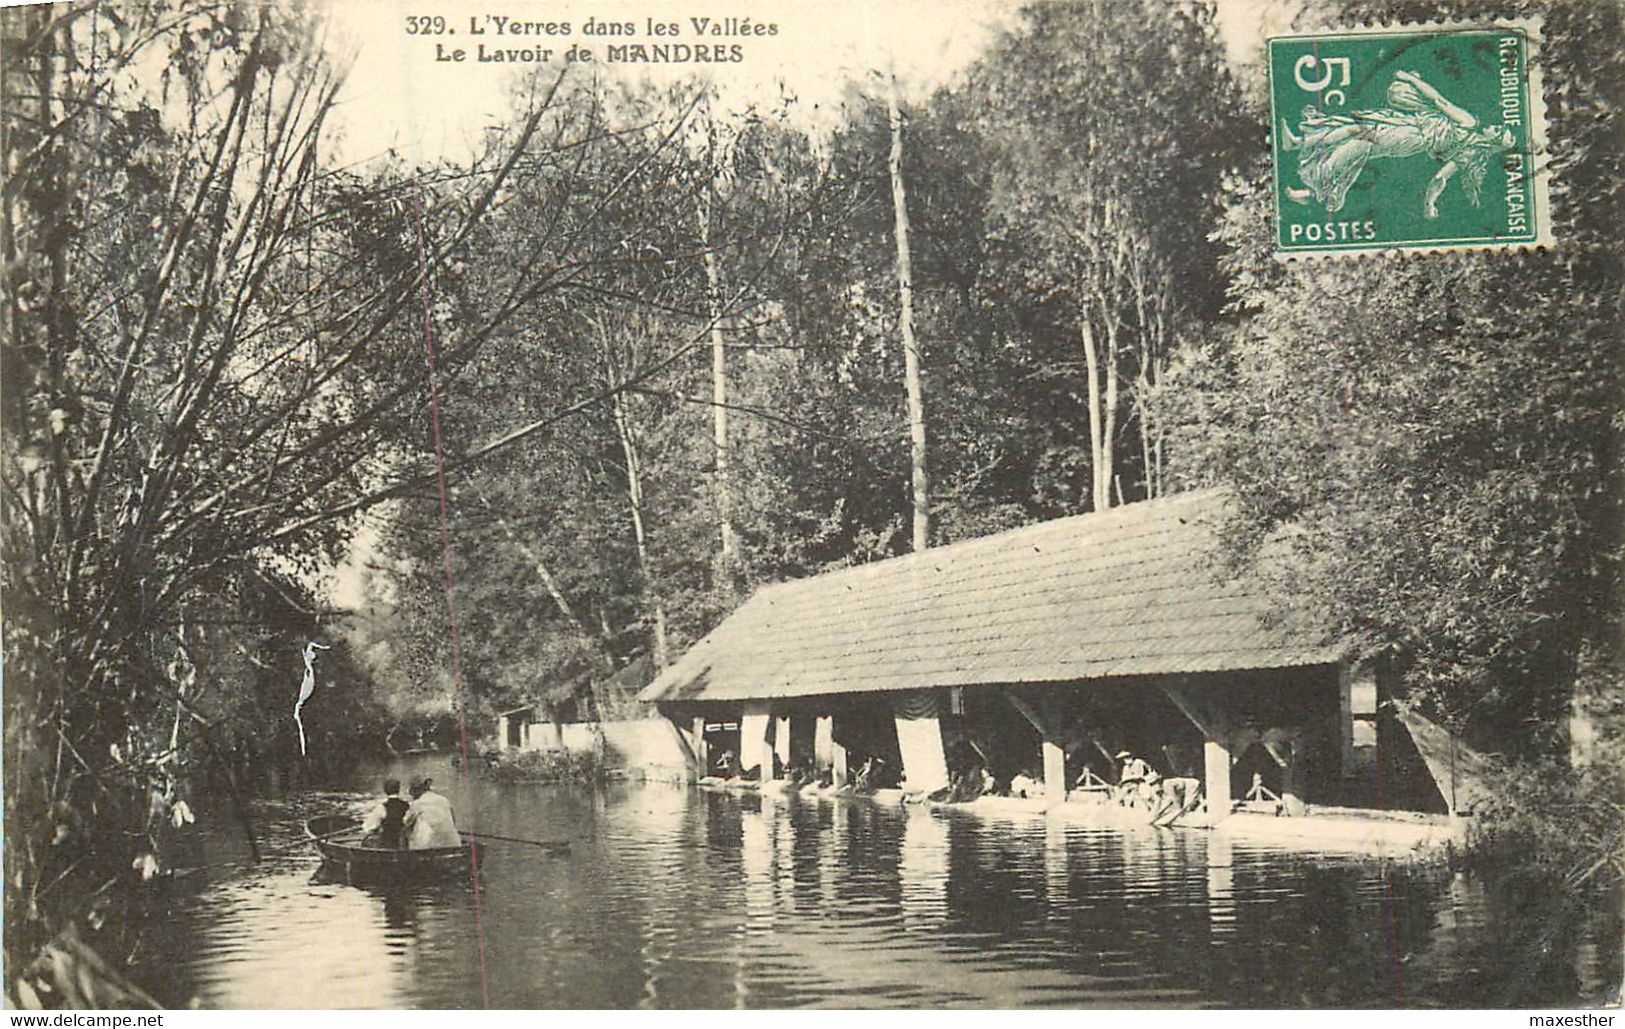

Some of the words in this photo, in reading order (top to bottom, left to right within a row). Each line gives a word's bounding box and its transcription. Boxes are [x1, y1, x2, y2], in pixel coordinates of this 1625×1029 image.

[405, 16, 456, 36] 329.
[469, 15, 572, 36] L'Yerres
[582, 16, 636, 36] dans
[646, 16, 680, 36] les
[690, 16, 779, 36] Vallées
[435, 44, 467, 63] Le
[477, 44, 553, 63] Lavoir
[564, 44, 594, 63] de
[607, 44, 744, 63] MANDRES
[1289, 221, 1377, 242] POSTES
